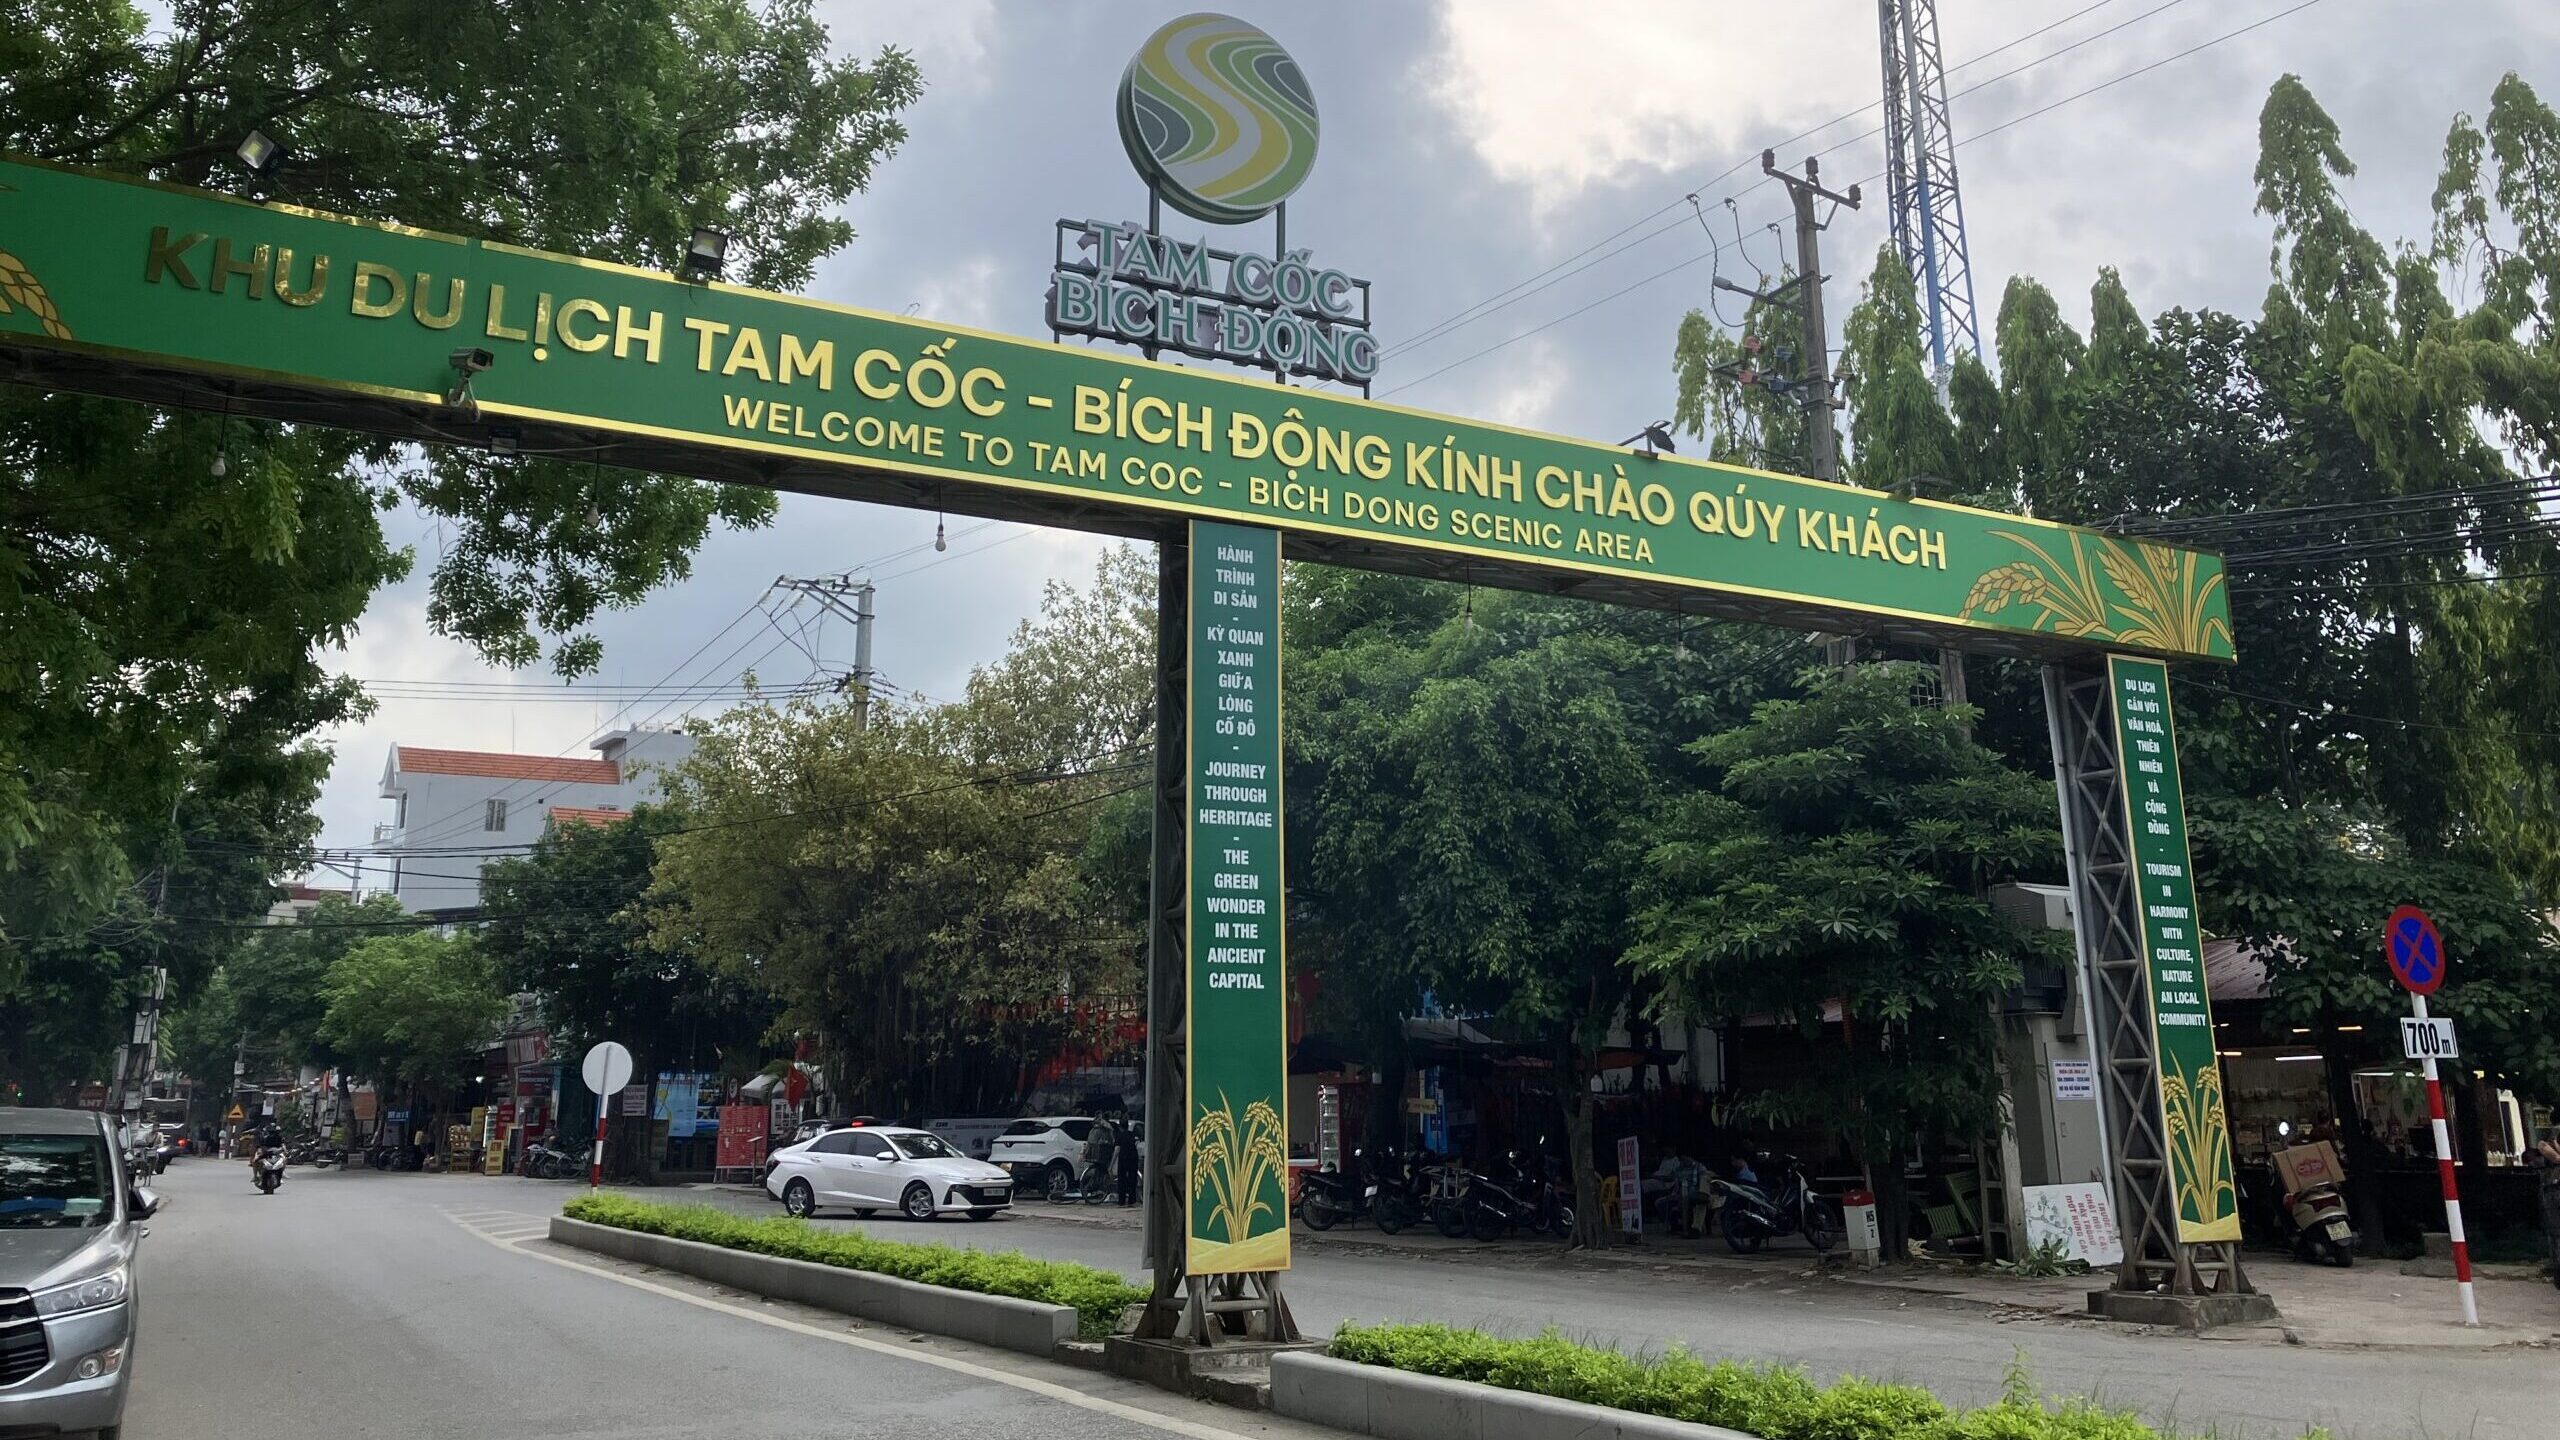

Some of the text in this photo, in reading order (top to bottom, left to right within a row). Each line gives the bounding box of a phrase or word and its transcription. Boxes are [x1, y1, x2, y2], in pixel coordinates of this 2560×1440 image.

[1086, 220, 1353, 319] TAM CỐC
[1052, 272, 1380, 379] BÍCH ĐỘNG
[145, 226, 1946, 571] KHU DU LỊCH TAM CỐC - BÍCH ĐỘNG KÍNH CHÀO QÚY KHÁCH
[723, 395, 945, 458] WELCOME
[960, 431, 1013, 467] TO
[1028, 441, 1106, 481] TAM
[1121, 457, 1203, 496] COC
[1249, 476, 1329, 515] BICH
[1344, 492, 1439, 532] DONG
[1451, 511, 1563, 550] SCENIC
[1574, 529, 1654, 564] AREA
[1217, 544, 1253, 564] HÀNH
[1215, 568, 1255, 586] TRÌNH
[1213, 590, 1257, 609] DI SẢN
[1207, 624, 1264, 646] KỲ QUAN
[1217, 650, 1254, 667] XANH
[1218, 671, 1254, 690] GIỮA
[2125, 678, 2156, 695] DU LỊCH
[1218, 694, 1253, 713] LÒNG
[1215, 716, 1256, 737] CỐ ĐÔ
[2136, 738, 2161, 754] THIÊN
[1205, 761, 1266, 780] JOURNEY
[2138, 758, 2163, 774] NHIÊN
[1204, 785, 1267, 803] THROUGH
[1199, 809, 1272, 827] HERRITAGE
[1223, 848, 1249, 865] THE
[2145, 863, 2182, 878] TOURISM
[1214, 873, 1258, 890] GREEN
[2162, 884, 2172, 897] IN
[1206, 897, 1266, 915] WONDER
[2149, 905, 2189, 919] HARMONY
[1215, 922, 1258, 939] IN THE
[2161, 926, 2183, 940] WITH
[1207, 947, 1266, 964] ANCIENT
[2156, 948, 2194, 964] CULTURE,
[1209, 972, 1264, 989] CAPITAL
[2162, 969, 2194, 983] NATURE
[2161, 991, 2199, 1005] AN LOCAL
[2158, 1012, 2206, 1027] COMMUNITY
[2406, 1022, 2452, 1055] 700 m
